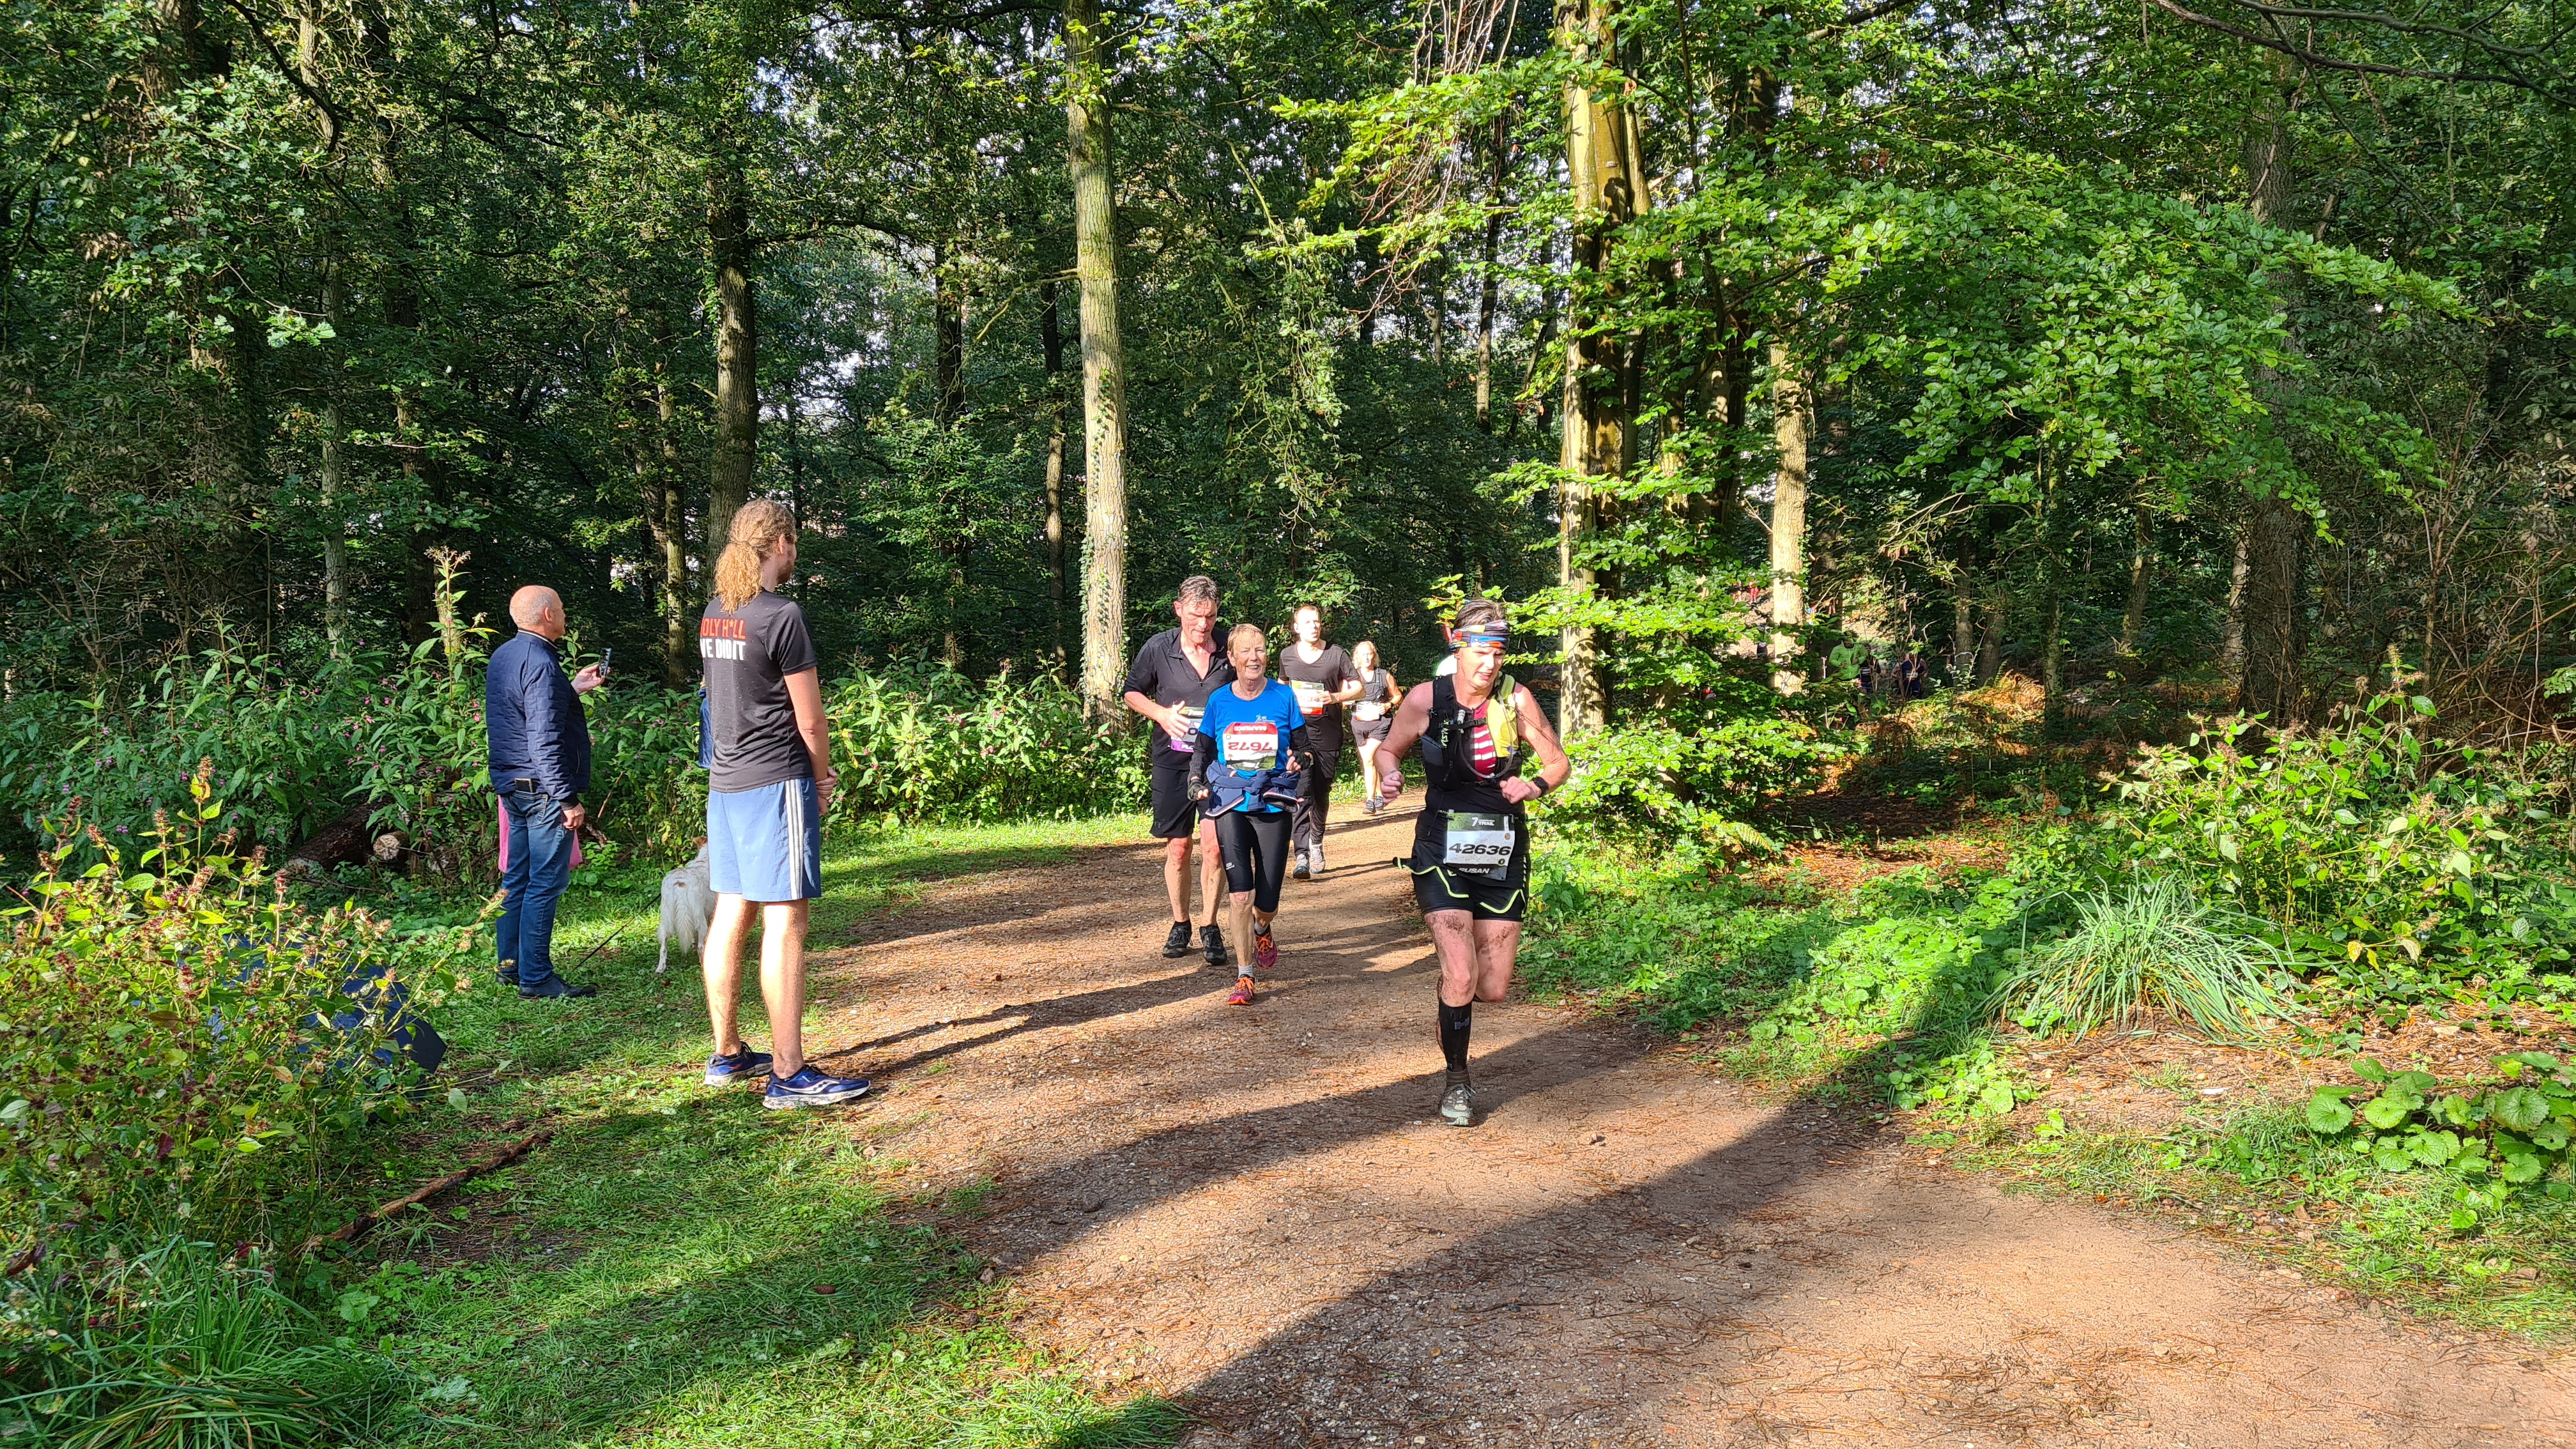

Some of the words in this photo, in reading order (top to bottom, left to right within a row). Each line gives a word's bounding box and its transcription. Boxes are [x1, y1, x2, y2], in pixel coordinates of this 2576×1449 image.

[1228, 742, 1273, 751] 7672
[1471, 816, 1479, 827] 7
[1448, 843, 1512, 856] 42636
